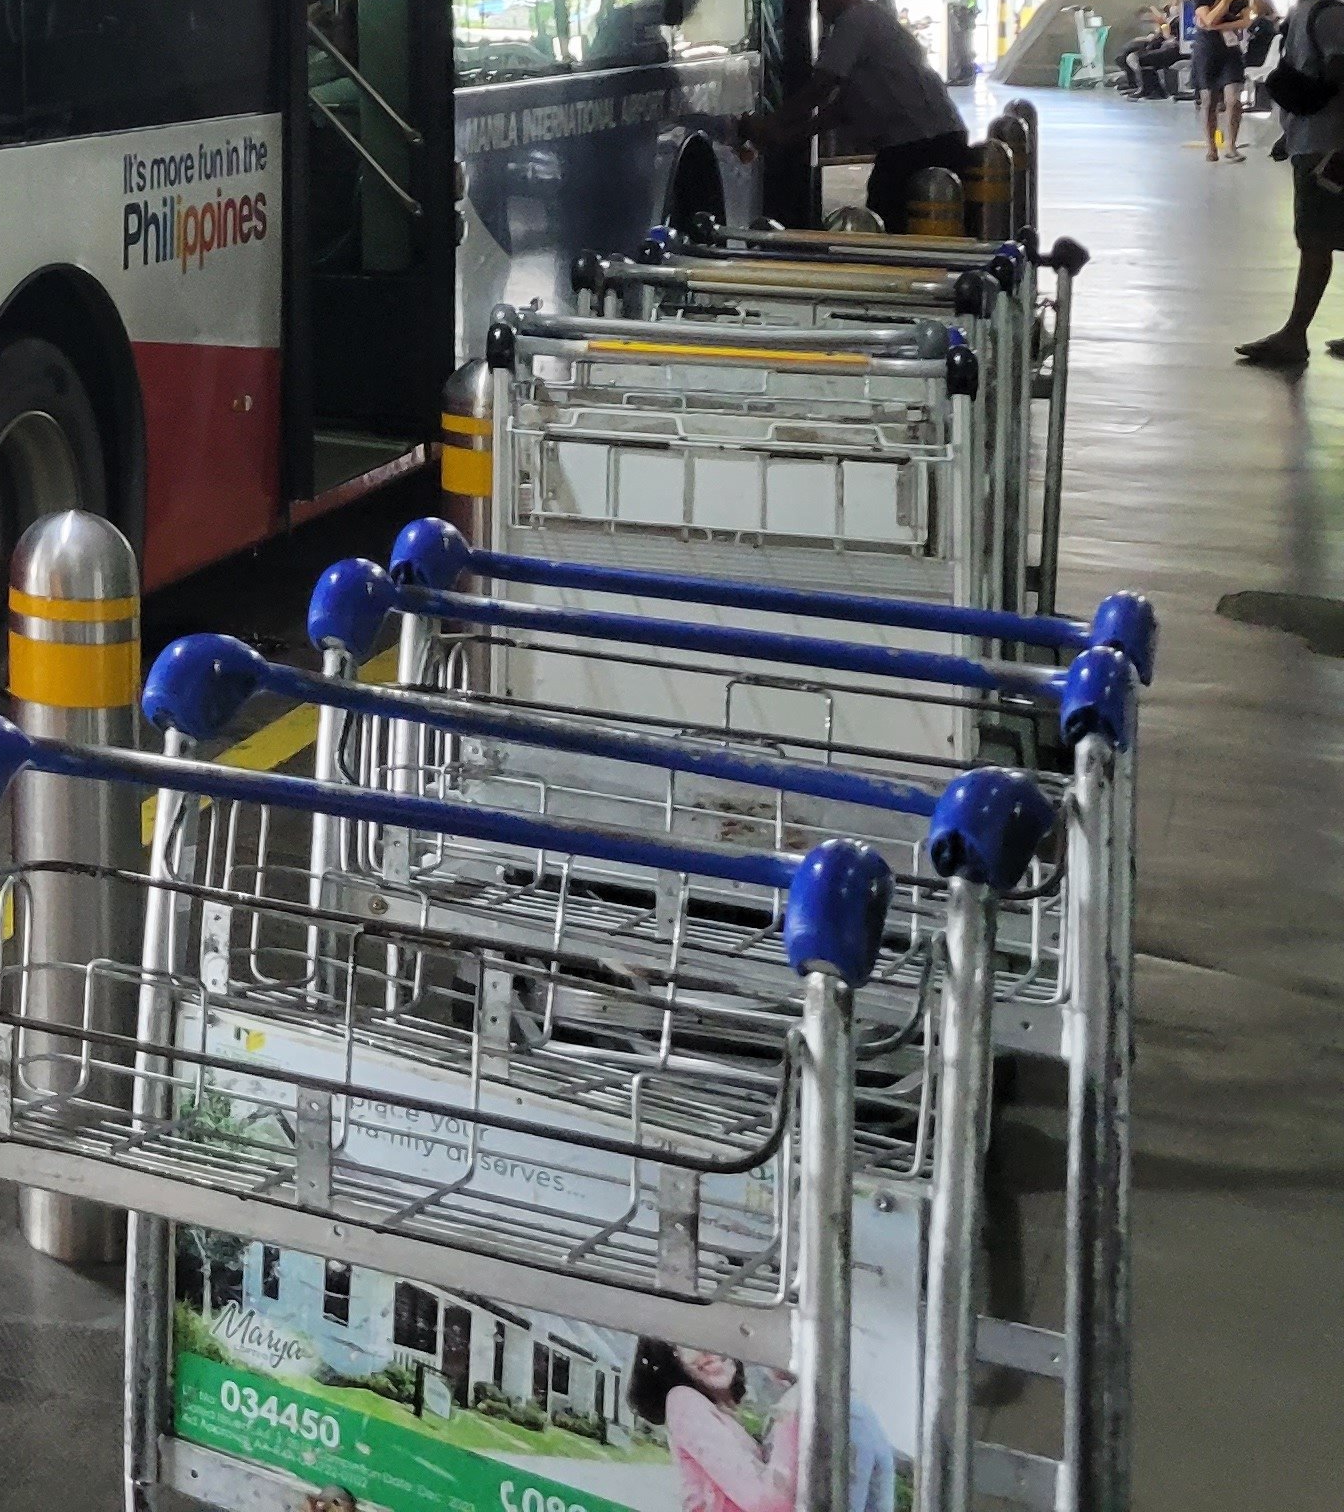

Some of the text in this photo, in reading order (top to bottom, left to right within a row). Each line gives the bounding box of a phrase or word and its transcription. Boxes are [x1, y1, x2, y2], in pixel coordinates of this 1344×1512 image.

[122, 136, 268, 195] It's more fun in the
[122, 187, 268, 275] Philippines
[210, 1298, 312, 1368] Marya
[219, 1379, 341, 1448] 034450
